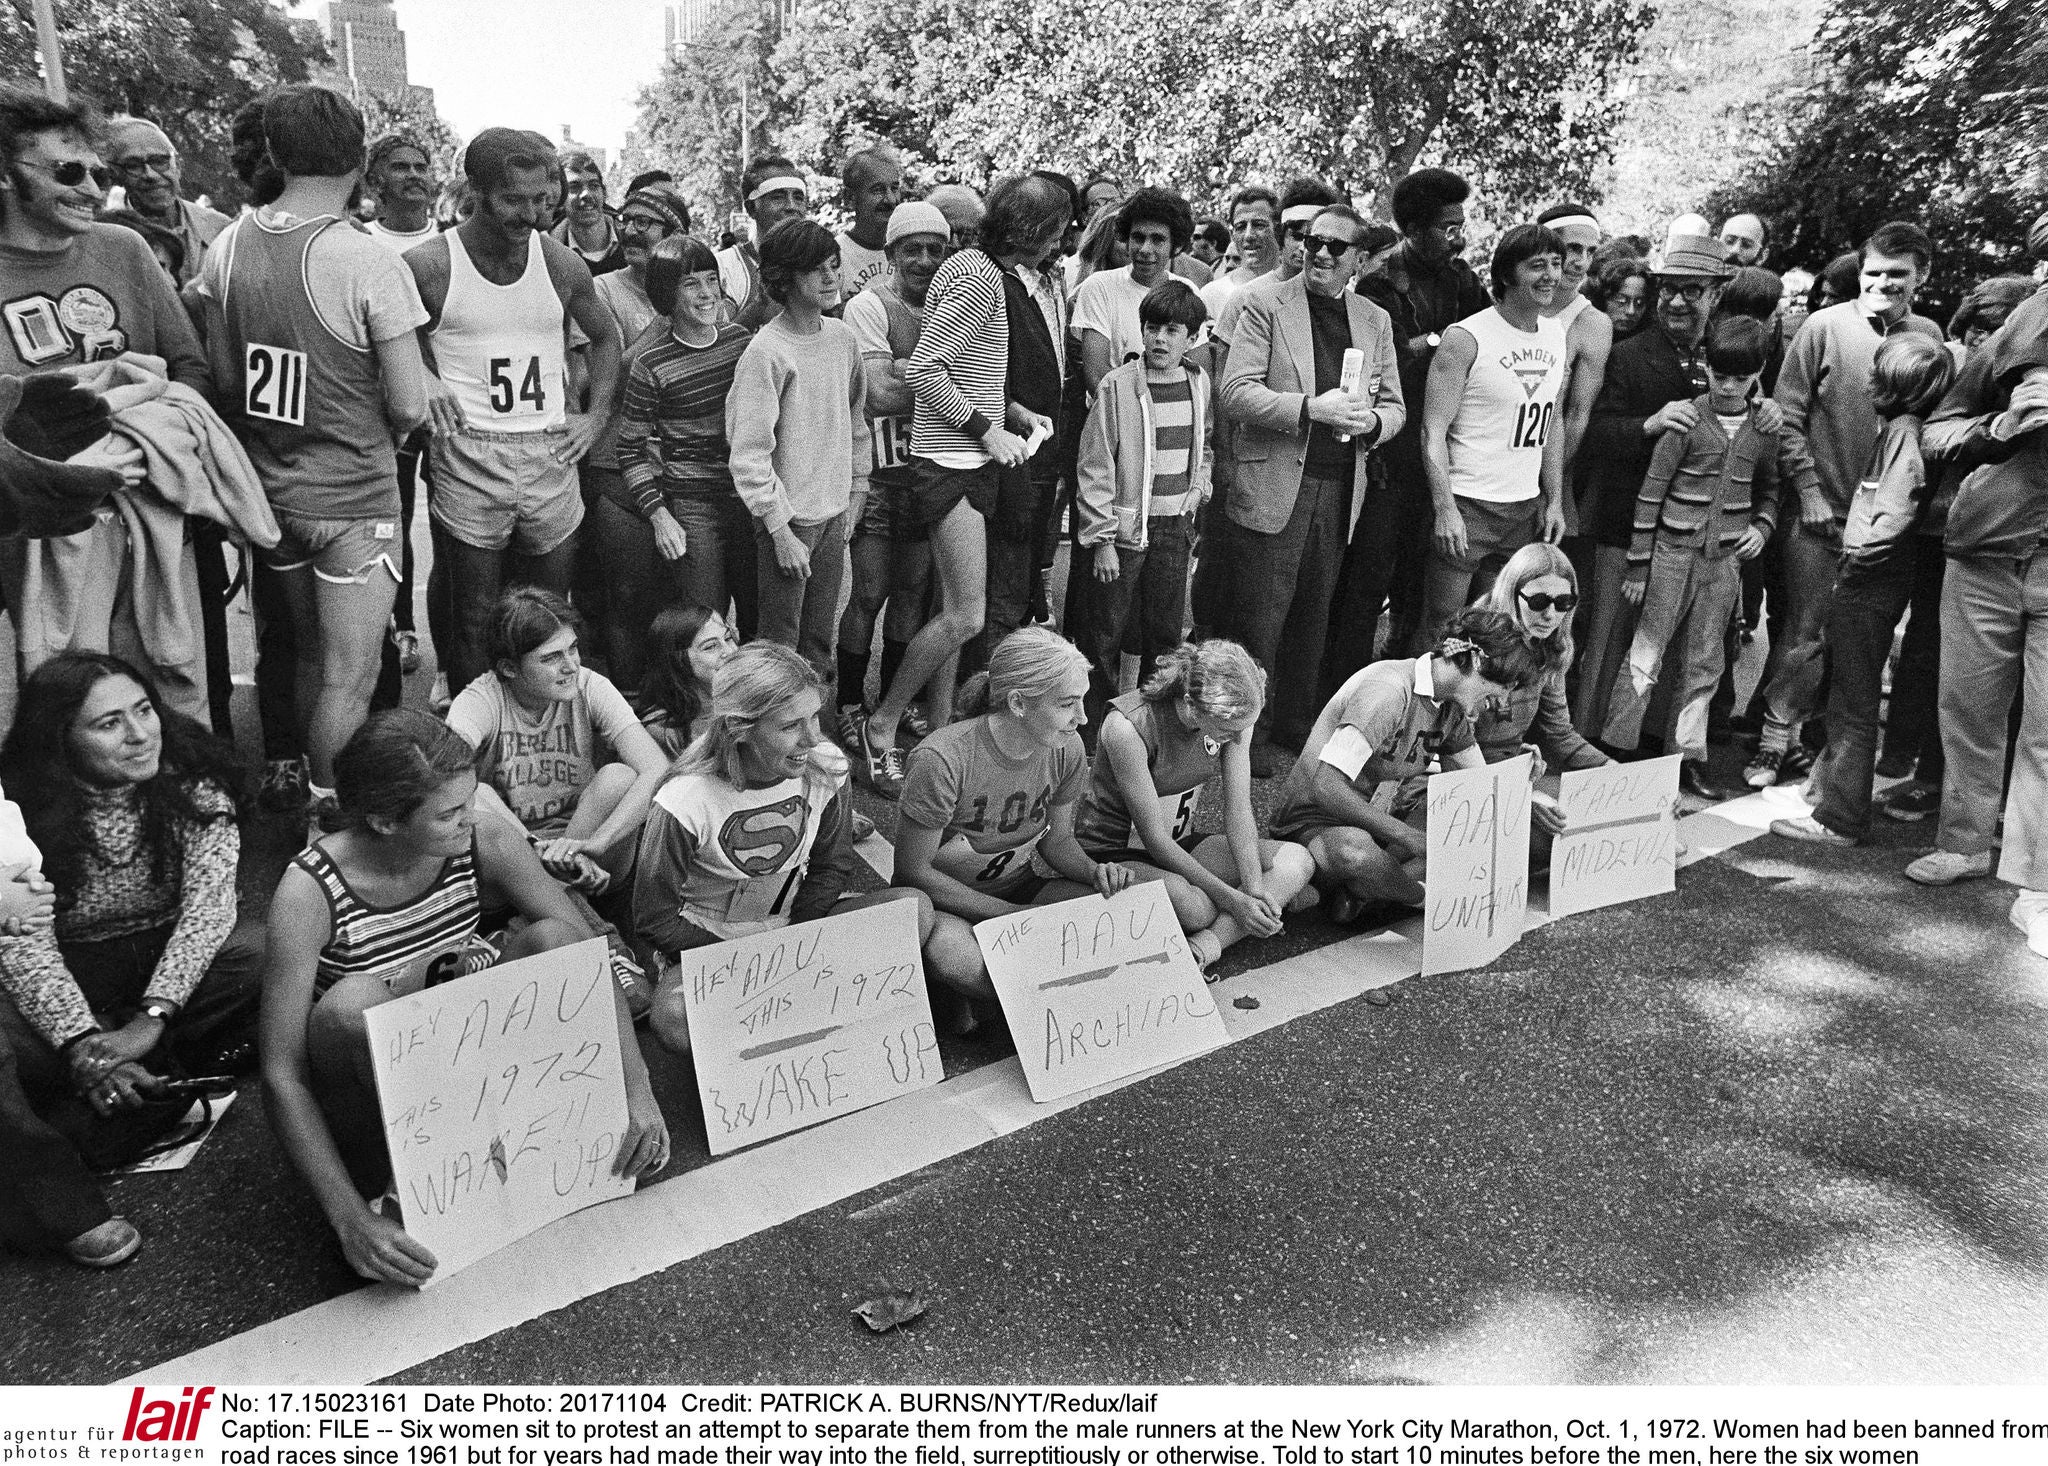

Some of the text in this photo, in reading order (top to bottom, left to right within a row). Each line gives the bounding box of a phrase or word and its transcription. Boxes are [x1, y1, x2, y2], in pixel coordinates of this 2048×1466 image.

[250, 349, 301, 420] 211
[490, 356, 546, 414] 54
[1499, 348, 1557, 370] CAMDEN
[1513, 402, 1554, 448] 120
[1172, 790, 1194, 841] 5
[1429, 783, 1465, 815] THE
[1443, 785, 1528, 848] AAU
[976, 850, 1015, 882] 8
[1469, 863, 1488, 882] IS
[992, 902, 1183, 967] THE AAU IS
[390, 962, 603, 1071] HEY AAU
[740, 963, 916, 1035] THIS IS 1972
[1045, 992, 1216, 1071] ARCHIAC
[389, 1041, 604, 1134] THIS 1972
[709, 1022, 937, 1134] WAKE UP
[403, 1128, 431, 1149] IS
